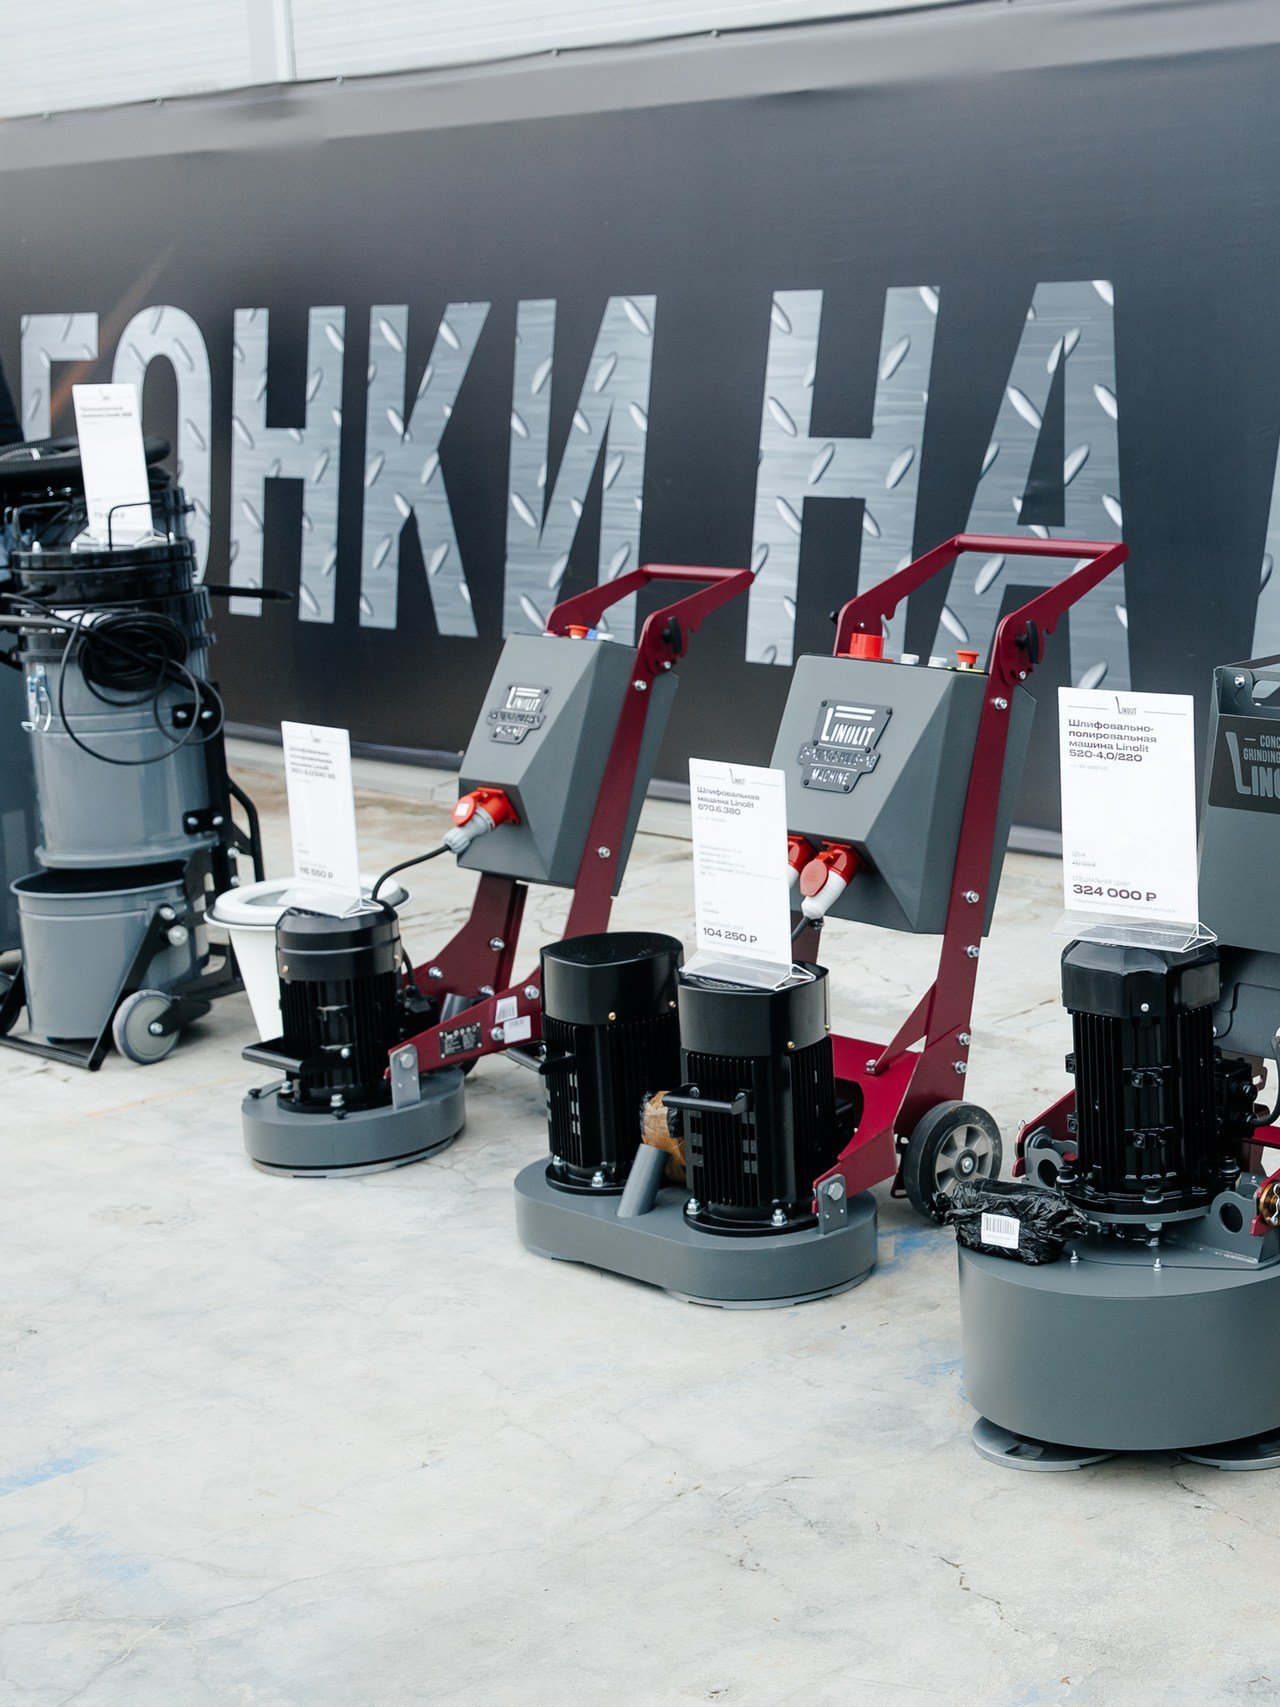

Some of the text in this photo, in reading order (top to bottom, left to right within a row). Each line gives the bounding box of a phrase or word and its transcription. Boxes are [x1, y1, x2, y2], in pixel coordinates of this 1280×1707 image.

[20, 294, 657, 643] ГОНКИ
[745, 279, 1131, 690] НА
[1068, 718, 1154, 734] Шлифовально-
[1068, 730, 1157, 743] полировальная
[1068, 740, 1150, 753] машина Linolit
[1243, 748, 1280, 764] GRINDING
[811, 768, 850, 786] MACHINE
[697, 786, 760, 801] Шлифовальная
[697, 796, 755, 809] машина Linolit
[1073, 884, 1104, 896] 324
[1107, 887, 1142, 901] 000
[703, 927, 722, 938] 104
[724, 930, 748, 943] 250
